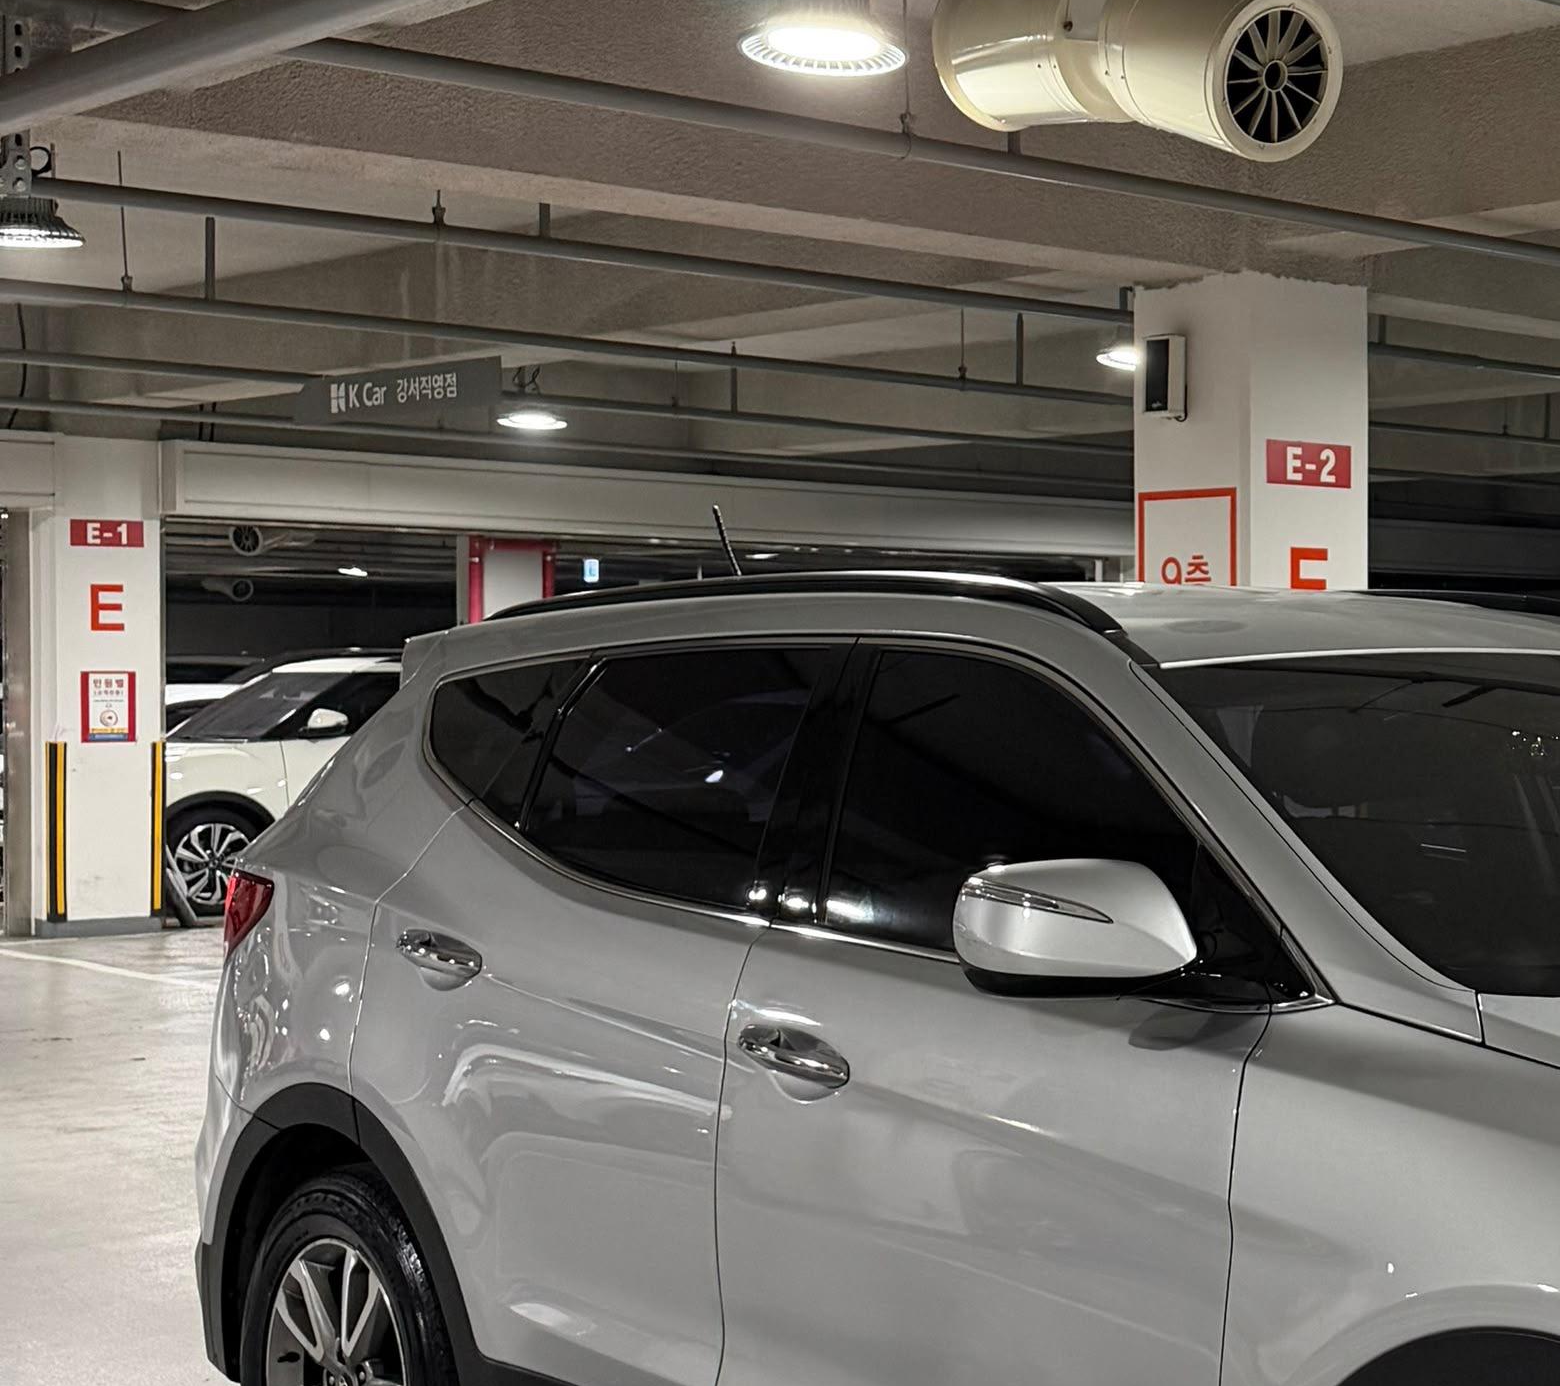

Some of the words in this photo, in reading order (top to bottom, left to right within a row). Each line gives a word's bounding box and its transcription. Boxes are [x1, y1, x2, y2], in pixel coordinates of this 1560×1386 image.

[348, 383, 361, 409] K
[362, 382, 387, 407] Car
[396, 372, 458, 404] 강서직영점
[1286, 446, 1336, 483] E-2
[86, 522, 128, 545] E-1
[90, 583, 125, 631] E
